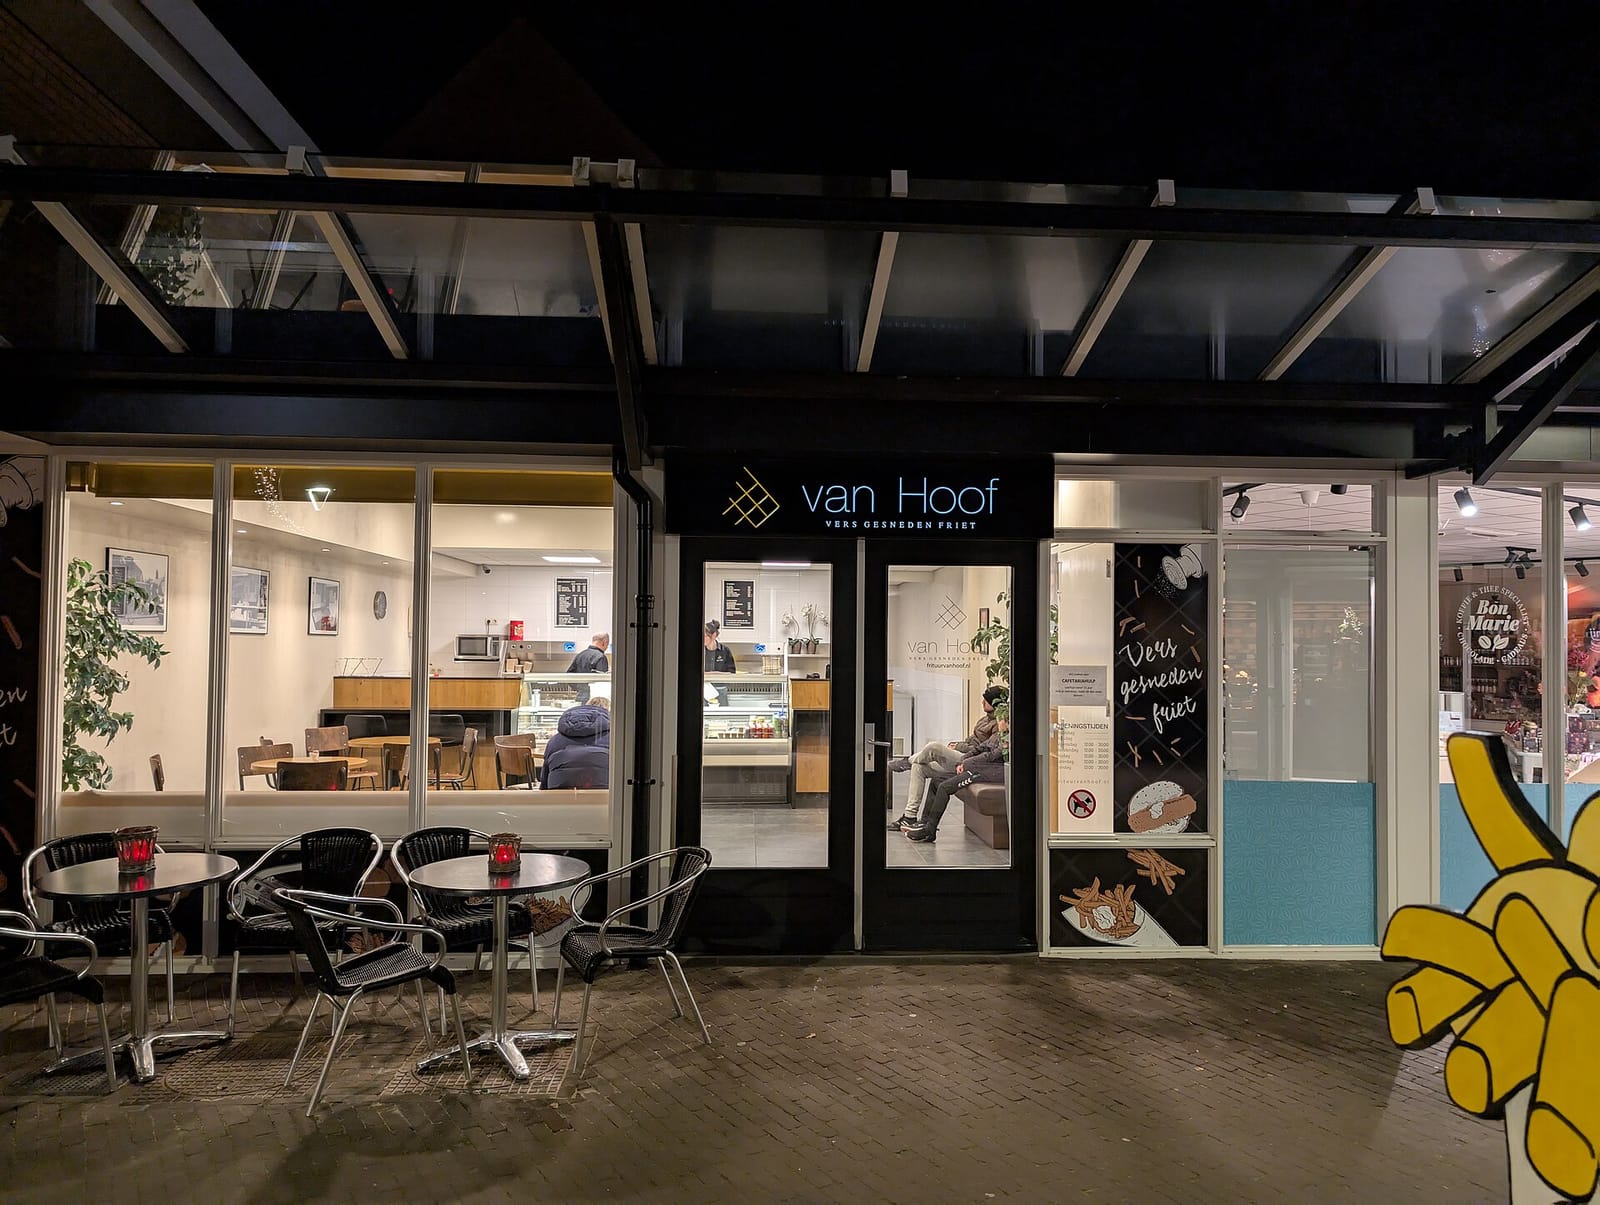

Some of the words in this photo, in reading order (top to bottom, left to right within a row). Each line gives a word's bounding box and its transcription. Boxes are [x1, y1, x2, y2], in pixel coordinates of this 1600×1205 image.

[802, 485, 875, 513] van
[899, 477, 1000, 514] Hoof
[825, 520, 858, 528] VERS
[863, 520, 933, 529] GESNEDEN
[938, 521, 977, 529] FRIET
[1476, 599, 1509, 615] Bon
[1477, 585, 1500, 595] THEE
[1500, 586, 1530, 626] SPECIALIST
[1465, 615, 1520, 632] Marie
[907, 641, 938, 654] van
[946, 638, 987, 654] Hoo
[1119, 638, 1178, 667] Vers
[1501, 633, 1529, 663] CADEAUS
[1120, 667, 1203, 705] gesneden
[1153, 695, 1197, 734] friet
